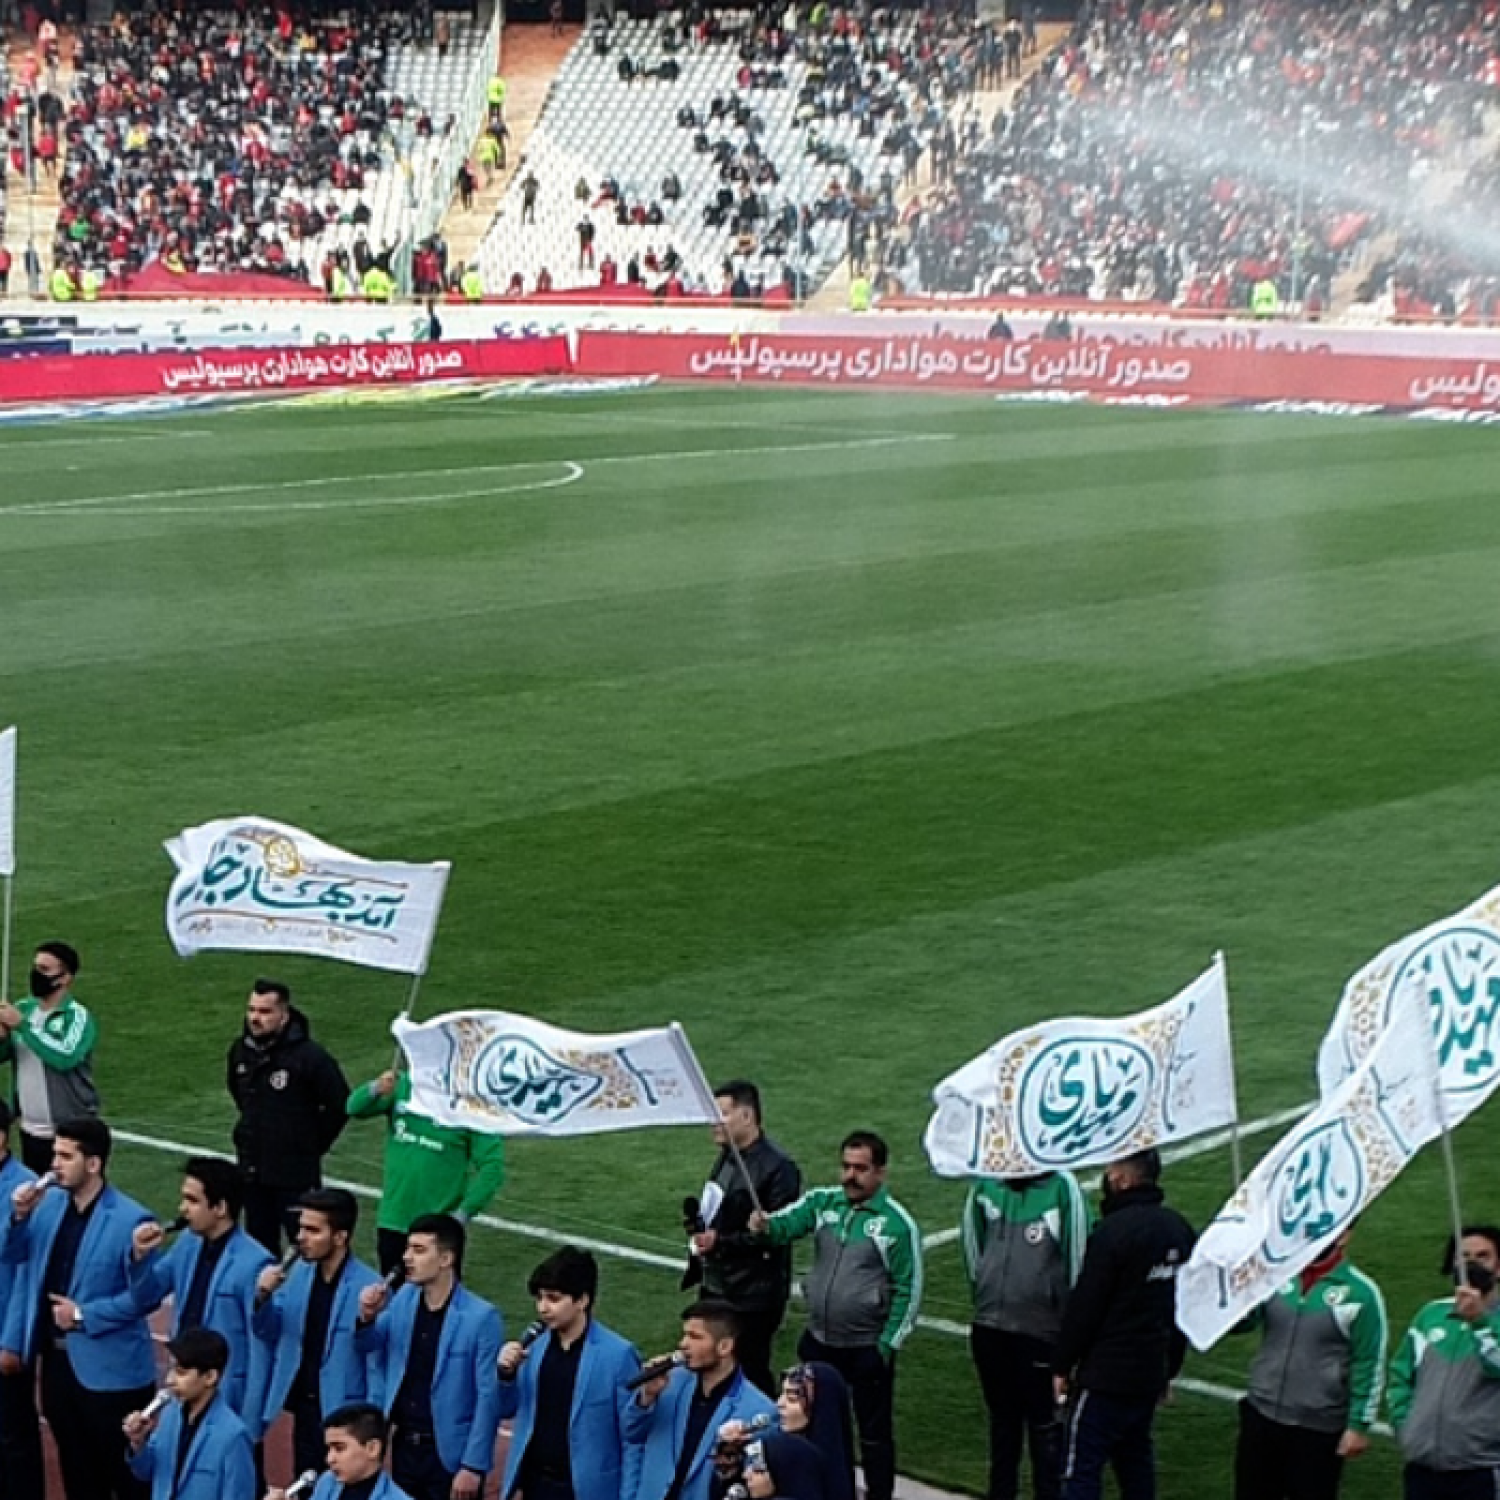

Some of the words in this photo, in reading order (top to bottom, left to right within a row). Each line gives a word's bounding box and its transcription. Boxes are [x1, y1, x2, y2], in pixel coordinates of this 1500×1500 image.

[417, 349, 463, 377] صدور
[689, 337, 843, 381] پرسپولیس
[845, 341, 958, 380] هواداری
[962, 344, 1031, 382] کارت
[1030, 344, 1111, 384] آنلاین
[1107, 356, 1192, 386] صدور
[1408, 363, 1500, 404] ولیس
